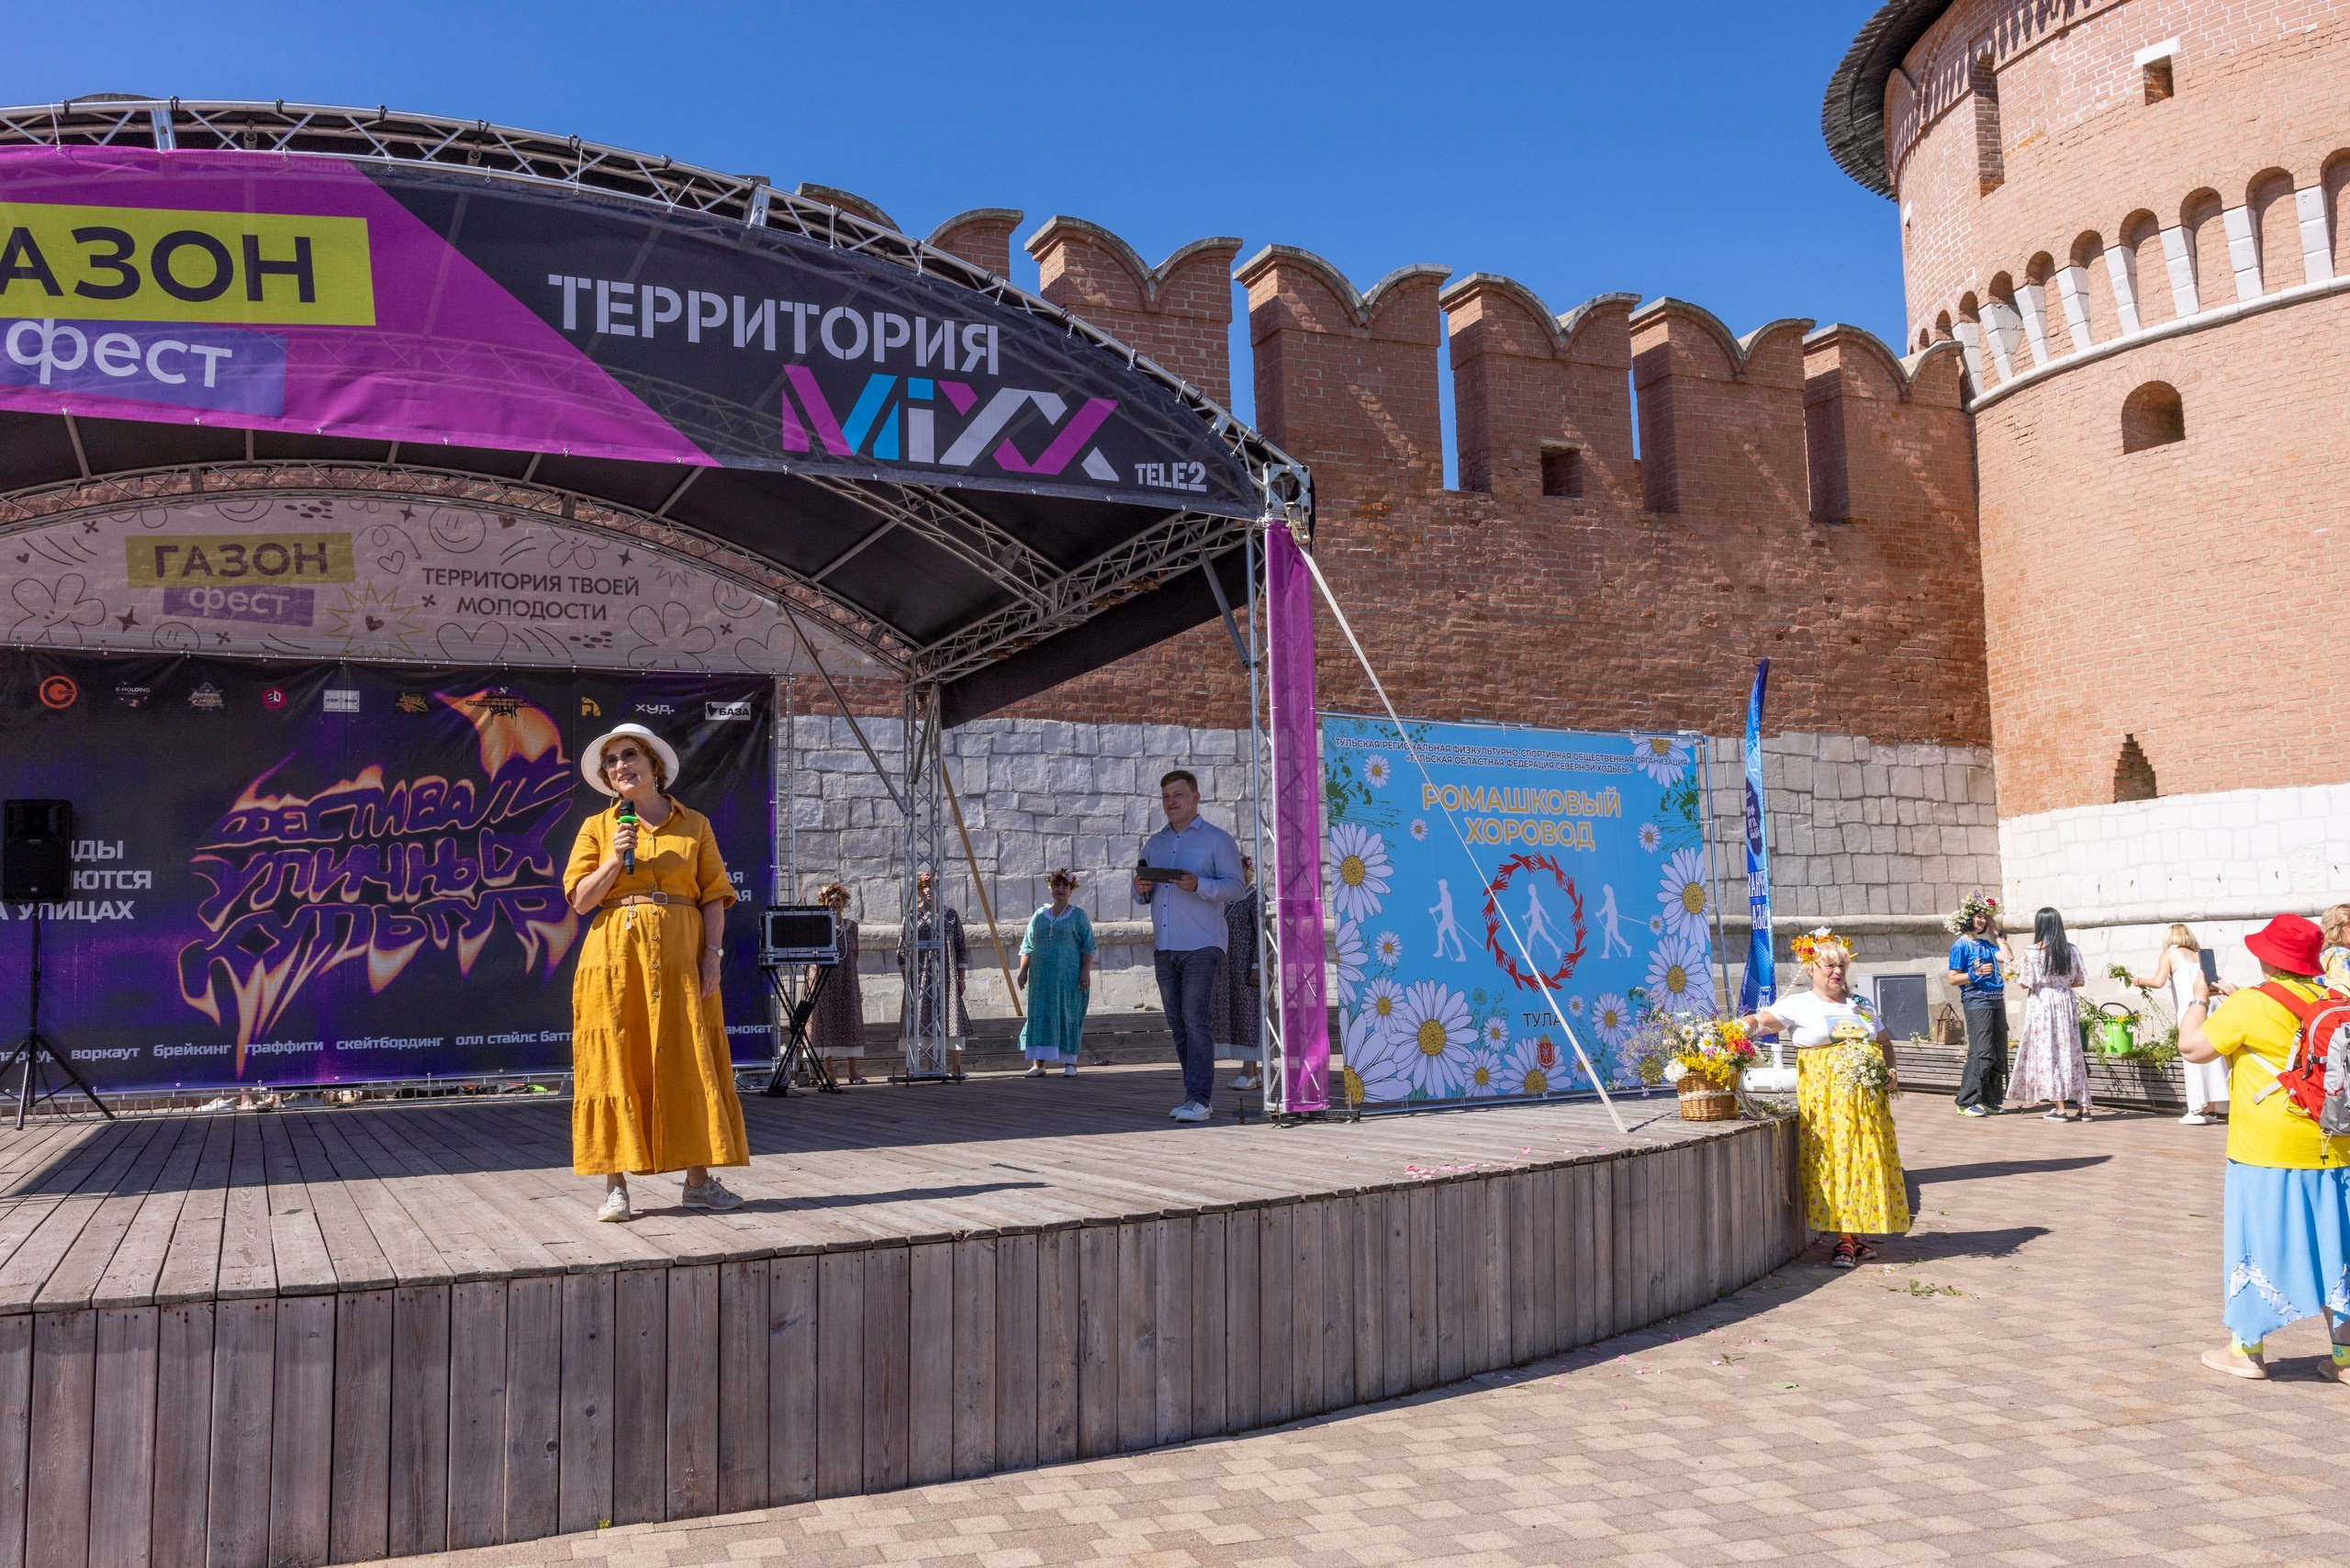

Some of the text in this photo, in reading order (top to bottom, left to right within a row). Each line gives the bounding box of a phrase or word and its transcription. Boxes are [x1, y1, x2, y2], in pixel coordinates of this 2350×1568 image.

[0, 226, 316, 303] АЗОН
[548, 274, 999, 375] ТЕРРИТОРИЯ
[6, 318, 233, 388] фест
[1135, 462, 1208, 493] TELE2
[154, 543, 328, 577] ГАЗОН
[422, 567, 639, 596] ТЕРРИТОРИЯ ТВОЕЙ
[188, 586, 291, 616] фест
[456, 597, 606, 621] МОЛОДОСТИ
[719, 708, 750, 716] БАЗА
[1335, 737, 1380, 749] ТУЛЬСКАЯ
[1452, 744, 1572, 760] ФИЗКУЛЬТУРНО-СПОРТИВНАЯ
[1572, 752, 1635, 765] ОБЩЕСТВЕННАЯ
[1635, 756, 1688, 767] ОРГАНИЗАЦИЯ
[1454, 756, 1505, 767] ОБЛАСТНАЯ
[1505, 759, 1553, 770] ФЕДЕРАЦИЯ
[1555, 762, 1595, 773] СЕВЕРНОЙ
[1422, 783, 1621, 818] РОМАШКОВЫЙ
[1465, 817, 1595, 852] ХОРОВОД
[71, 870, 151, 890] ЮТСЯ
[18, 901, 135, 923] УЛИЦАХ
[71, 1047, 140, 1061] воркаут
[153, 1043, 231, 1059] брейкинг
[244, 1040, 323, 1055] граффити
[336, 1036, 444, 1051] скейтбординг
[455, 1036, 484, 1046] олл
[487, 1031, 537, 1045] стайлс
[540, 1030, 574, 1043] батт
[724, 1025, 772, 1035] амокат
